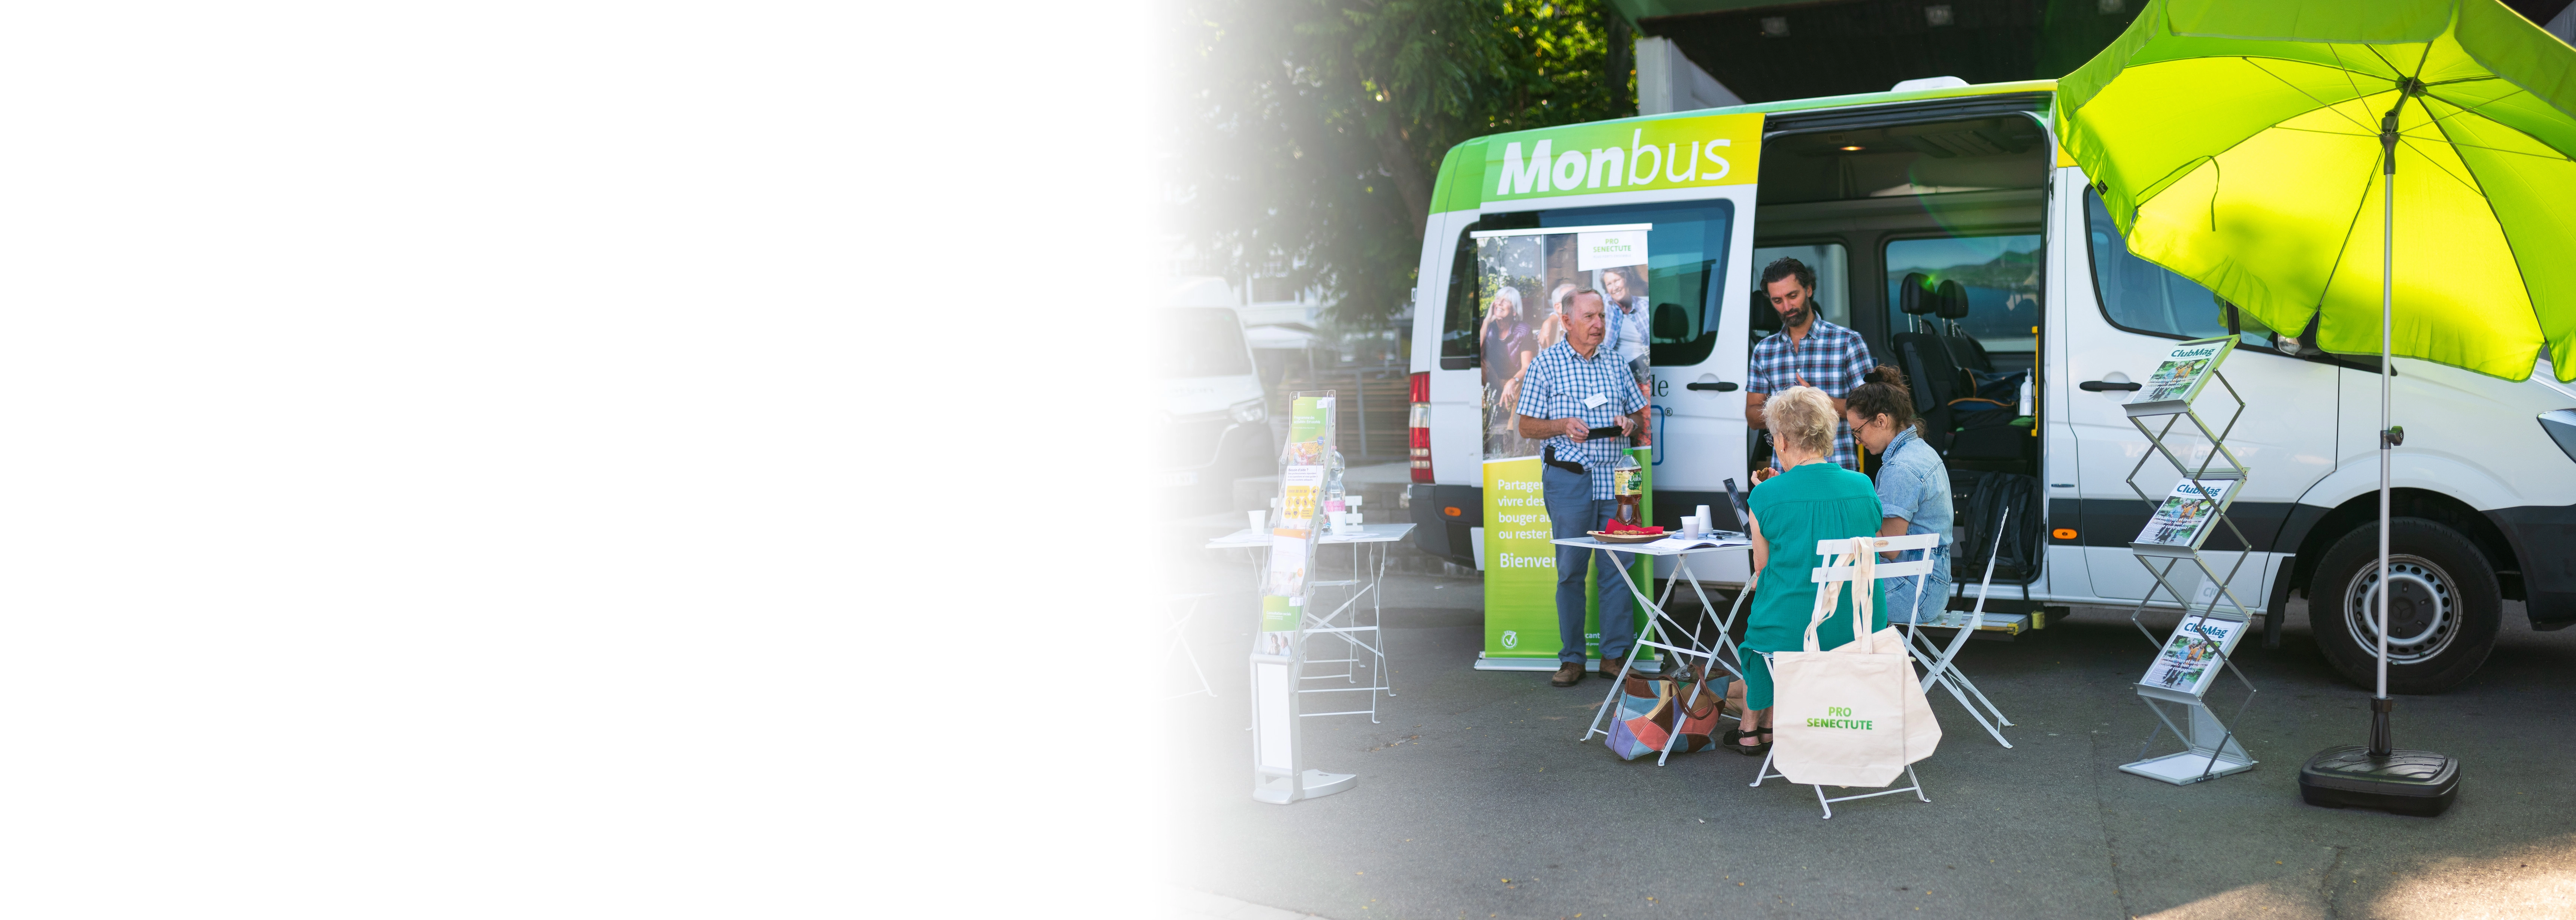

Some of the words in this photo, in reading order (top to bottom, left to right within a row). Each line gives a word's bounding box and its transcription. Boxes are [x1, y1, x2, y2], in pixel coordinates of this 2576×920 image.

[1496, 128, 1731, 196] Monbus
[2171, 348, 2216, 357] ClubMag
[1498, 479, 1543, 493] Partager
[1498, 495, 1523, 506] vivre
[1526, 495, 1545, 506] des
[1498, 511, 1537, 526] bouger
[1499, 531, 1512, 539] ou
[1515, 529, 1548, 539] rester
[1828, 706, 1852, 717] PRO
[1807, 718, 1873, 730] SENECTUTE
